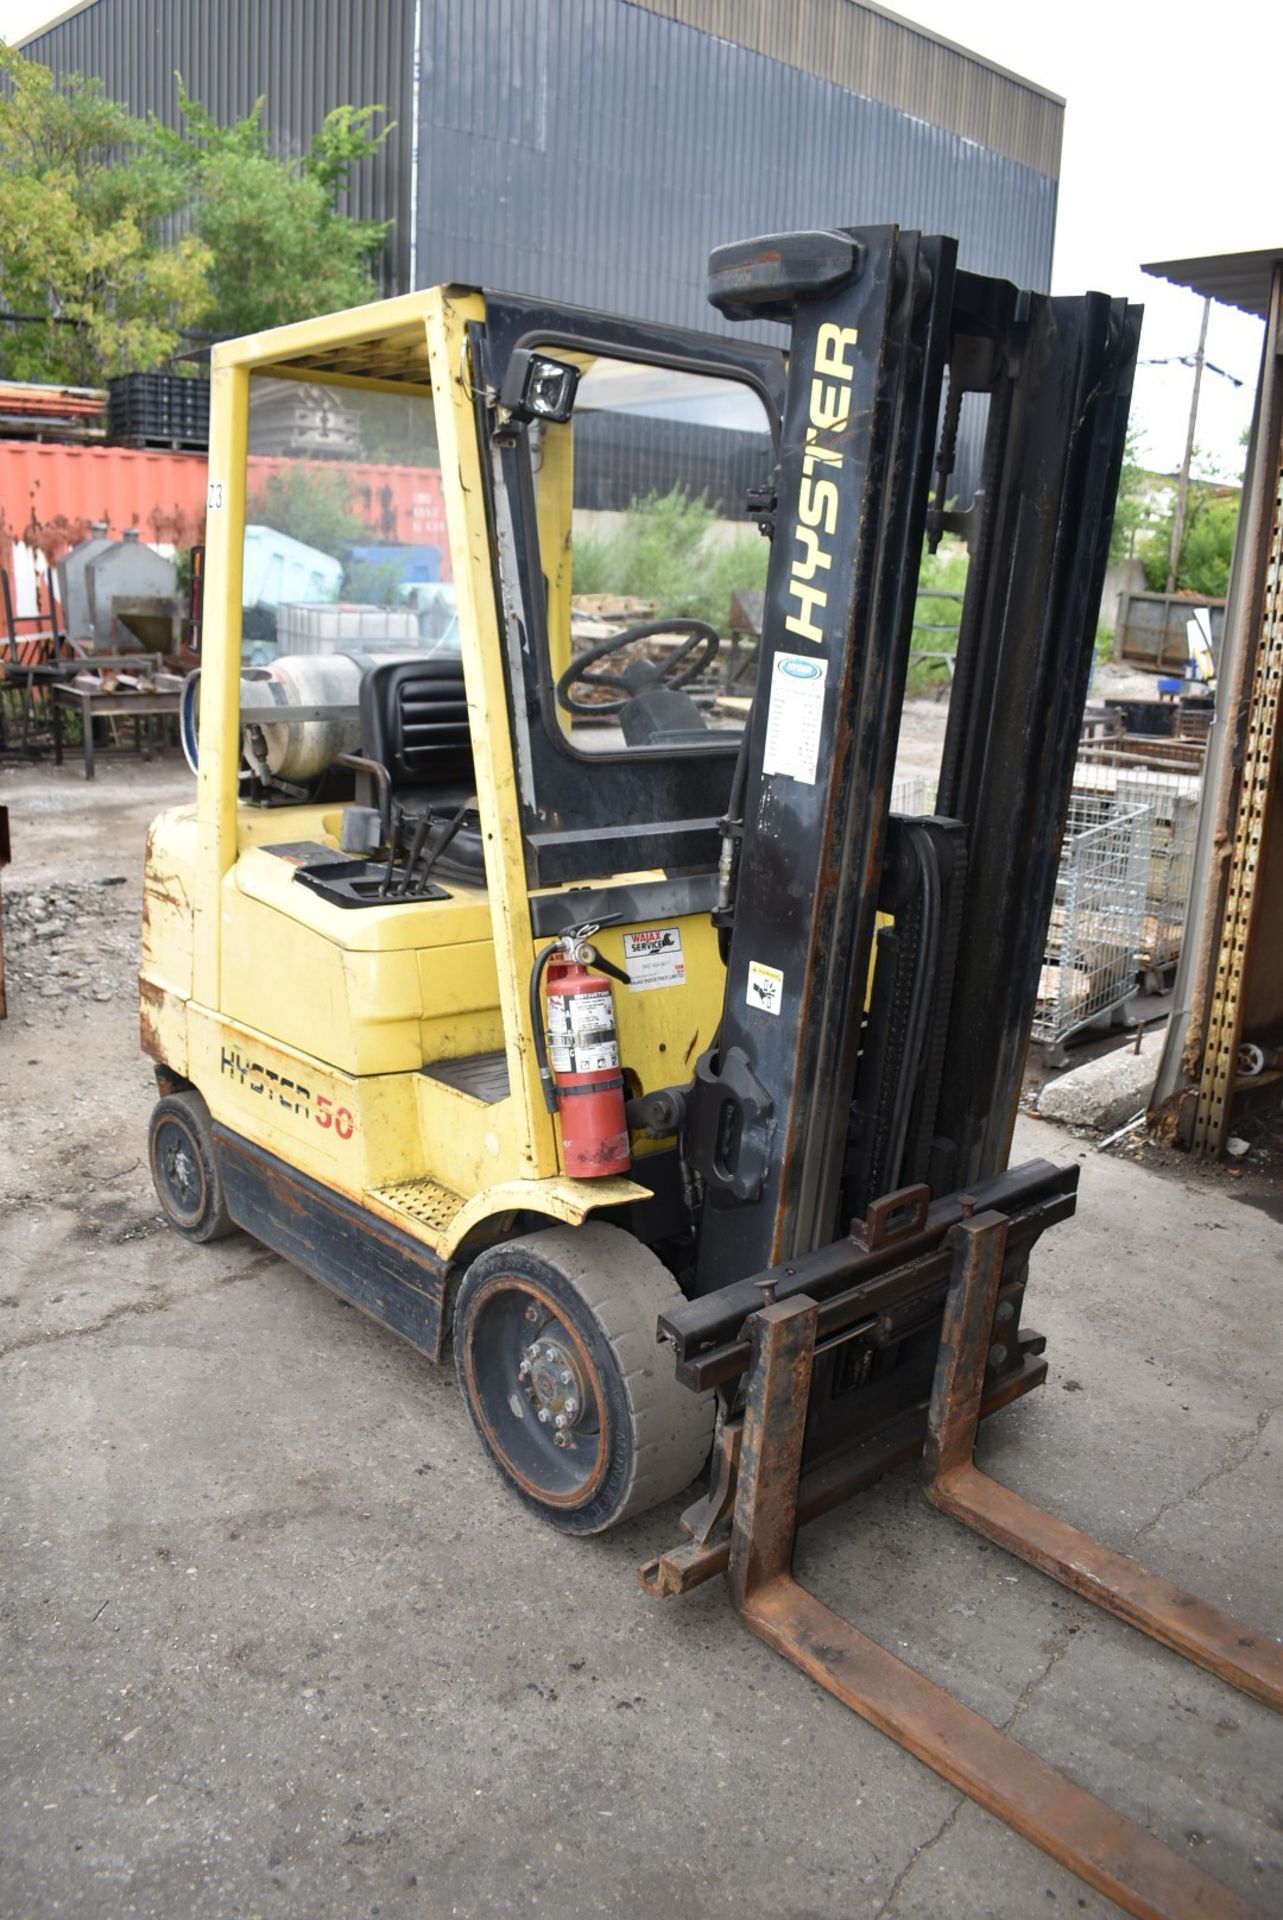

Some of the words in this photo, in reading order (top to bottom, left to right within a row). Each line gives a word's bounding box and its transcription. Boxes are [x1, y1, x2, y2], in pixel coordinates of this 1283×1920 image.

[785, 322, 858, 643] HYSTER
[631, 931, 661, 943] WAJAX
[632, 941, 663, 952] SERVICE
[315, 1094, 354, 1140] 50
